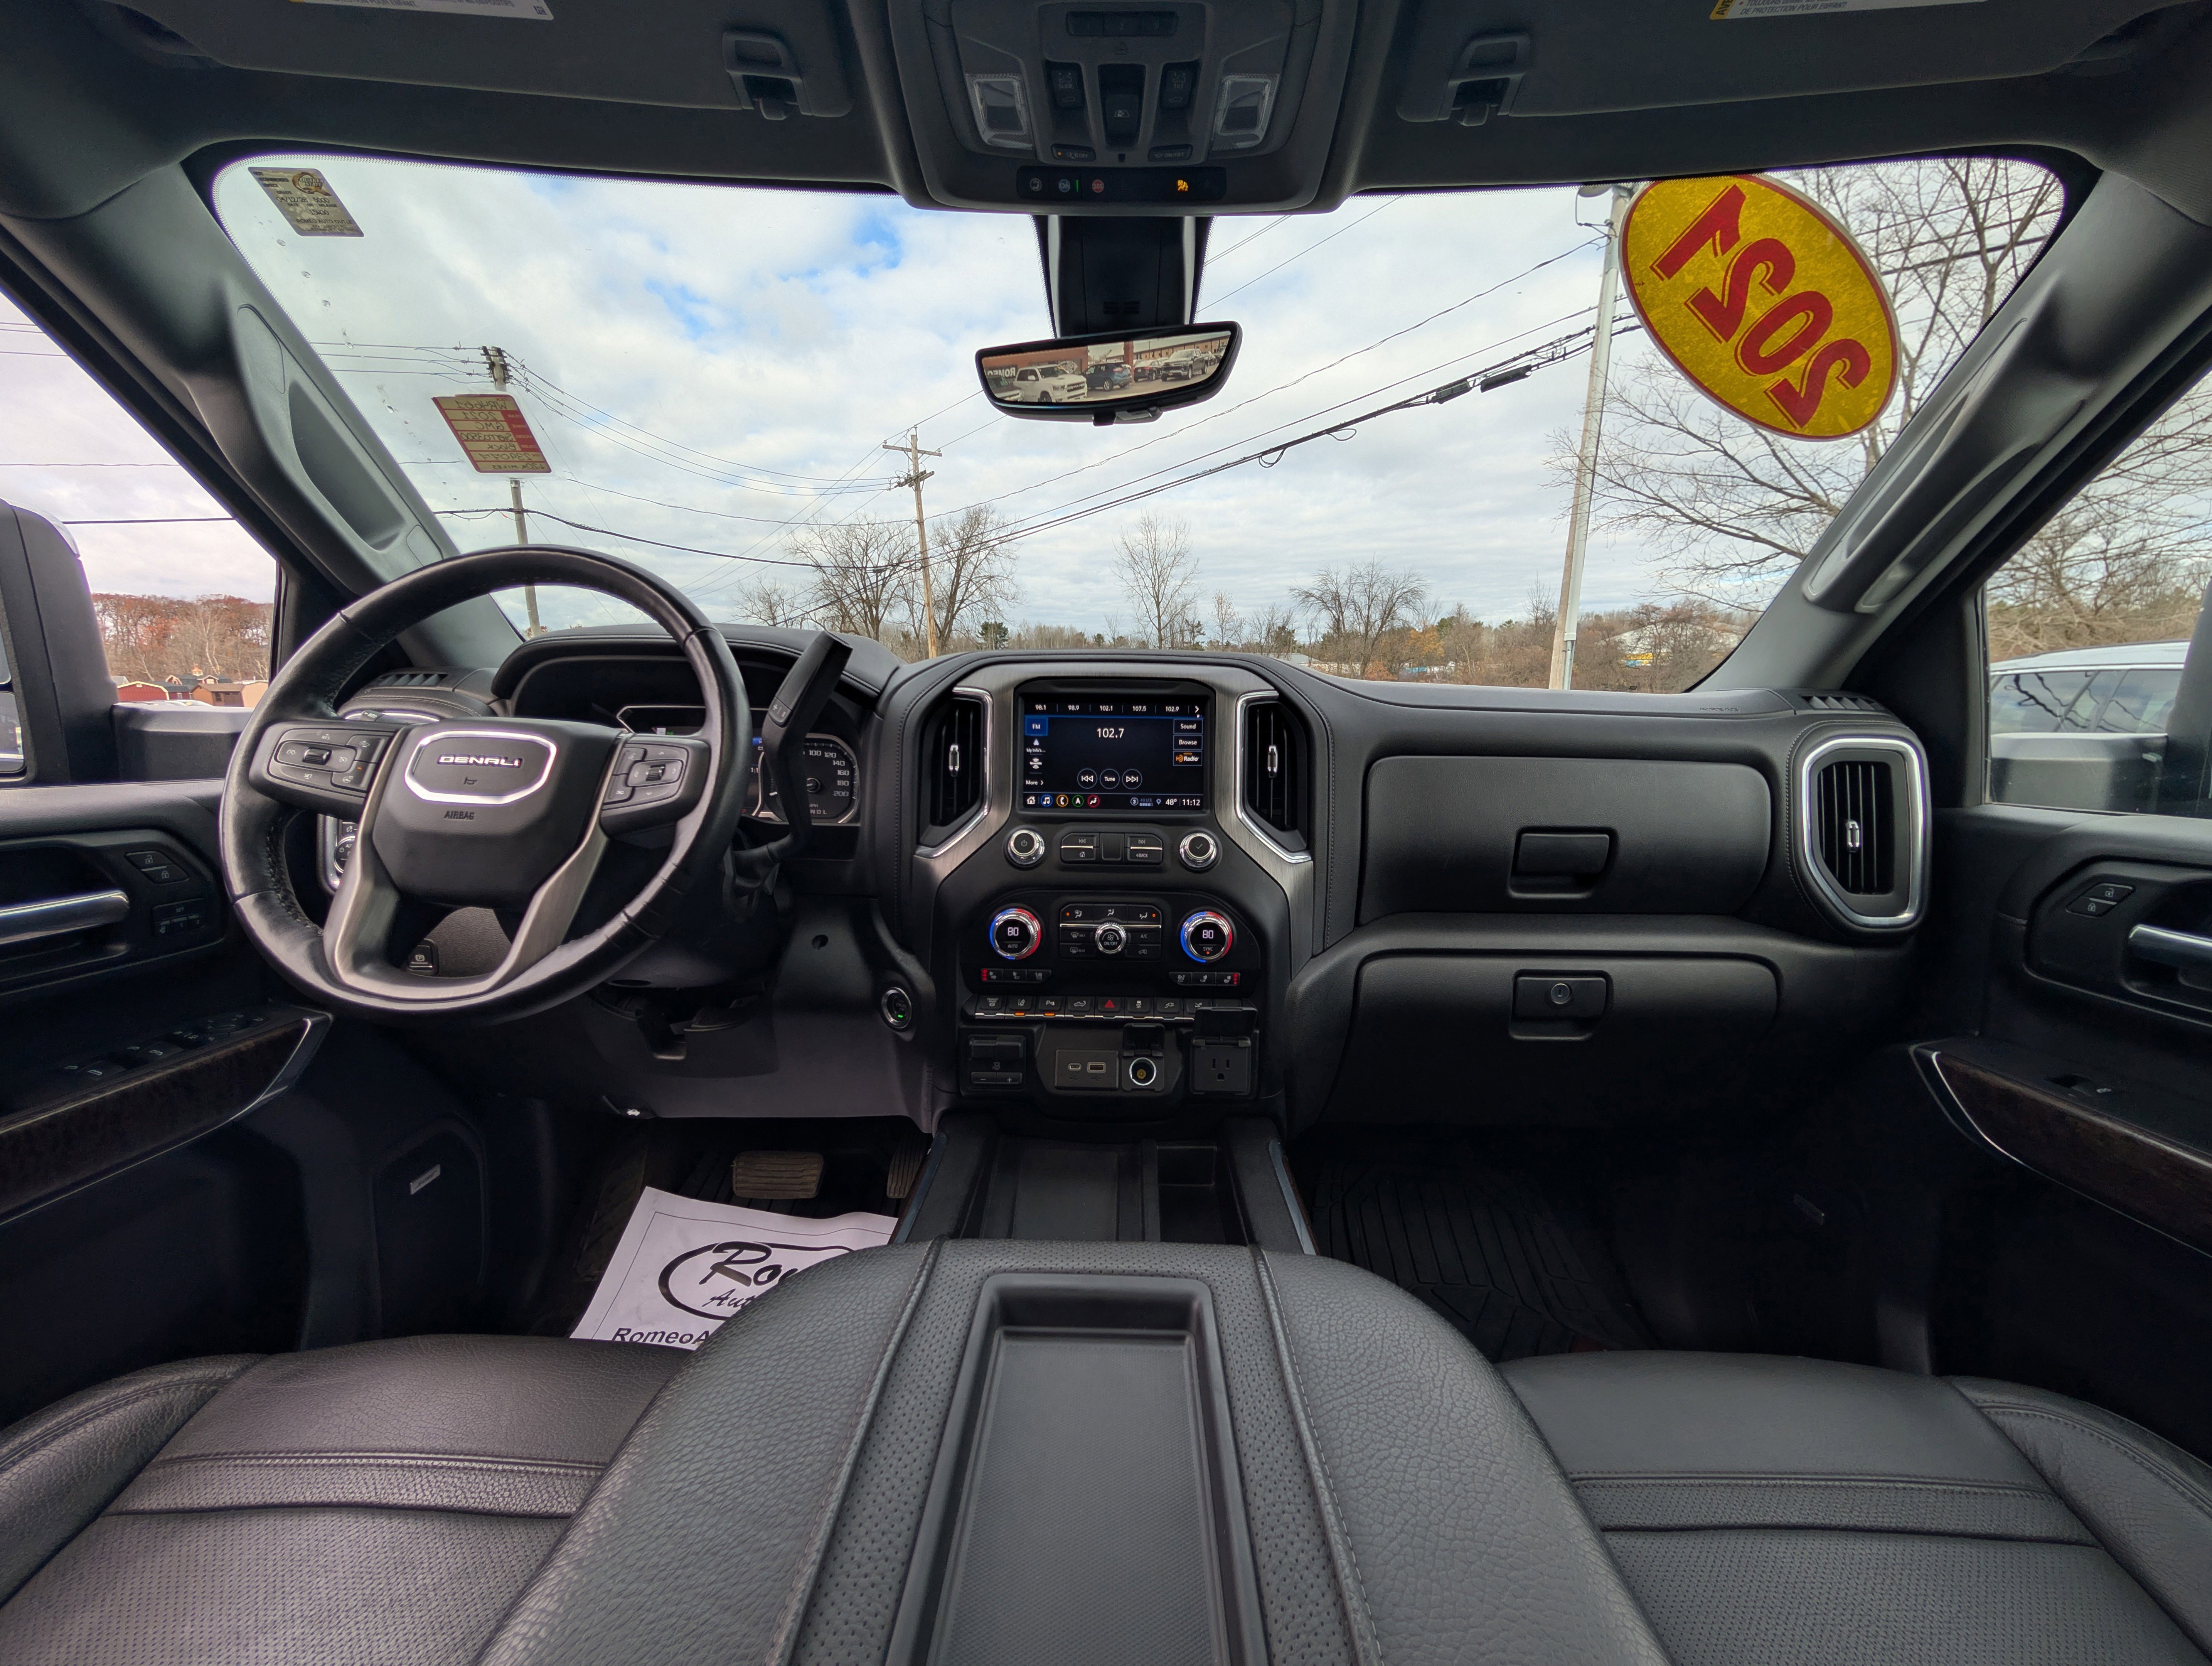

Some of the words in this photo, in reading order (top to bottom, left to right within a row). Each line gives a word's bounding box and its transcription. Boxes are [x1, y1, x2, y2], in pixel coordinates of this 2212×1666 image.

[1751, 5, 1798, 14] PROTECTION
[1097, 728, 1124, 738] 102.7
[438, 755, 522, 767] DENALI
[444, 811, 474, 820] AIRBAG
[1007, 927, 1019, 936] 80
[1202, 930, 1213, 939] 80
